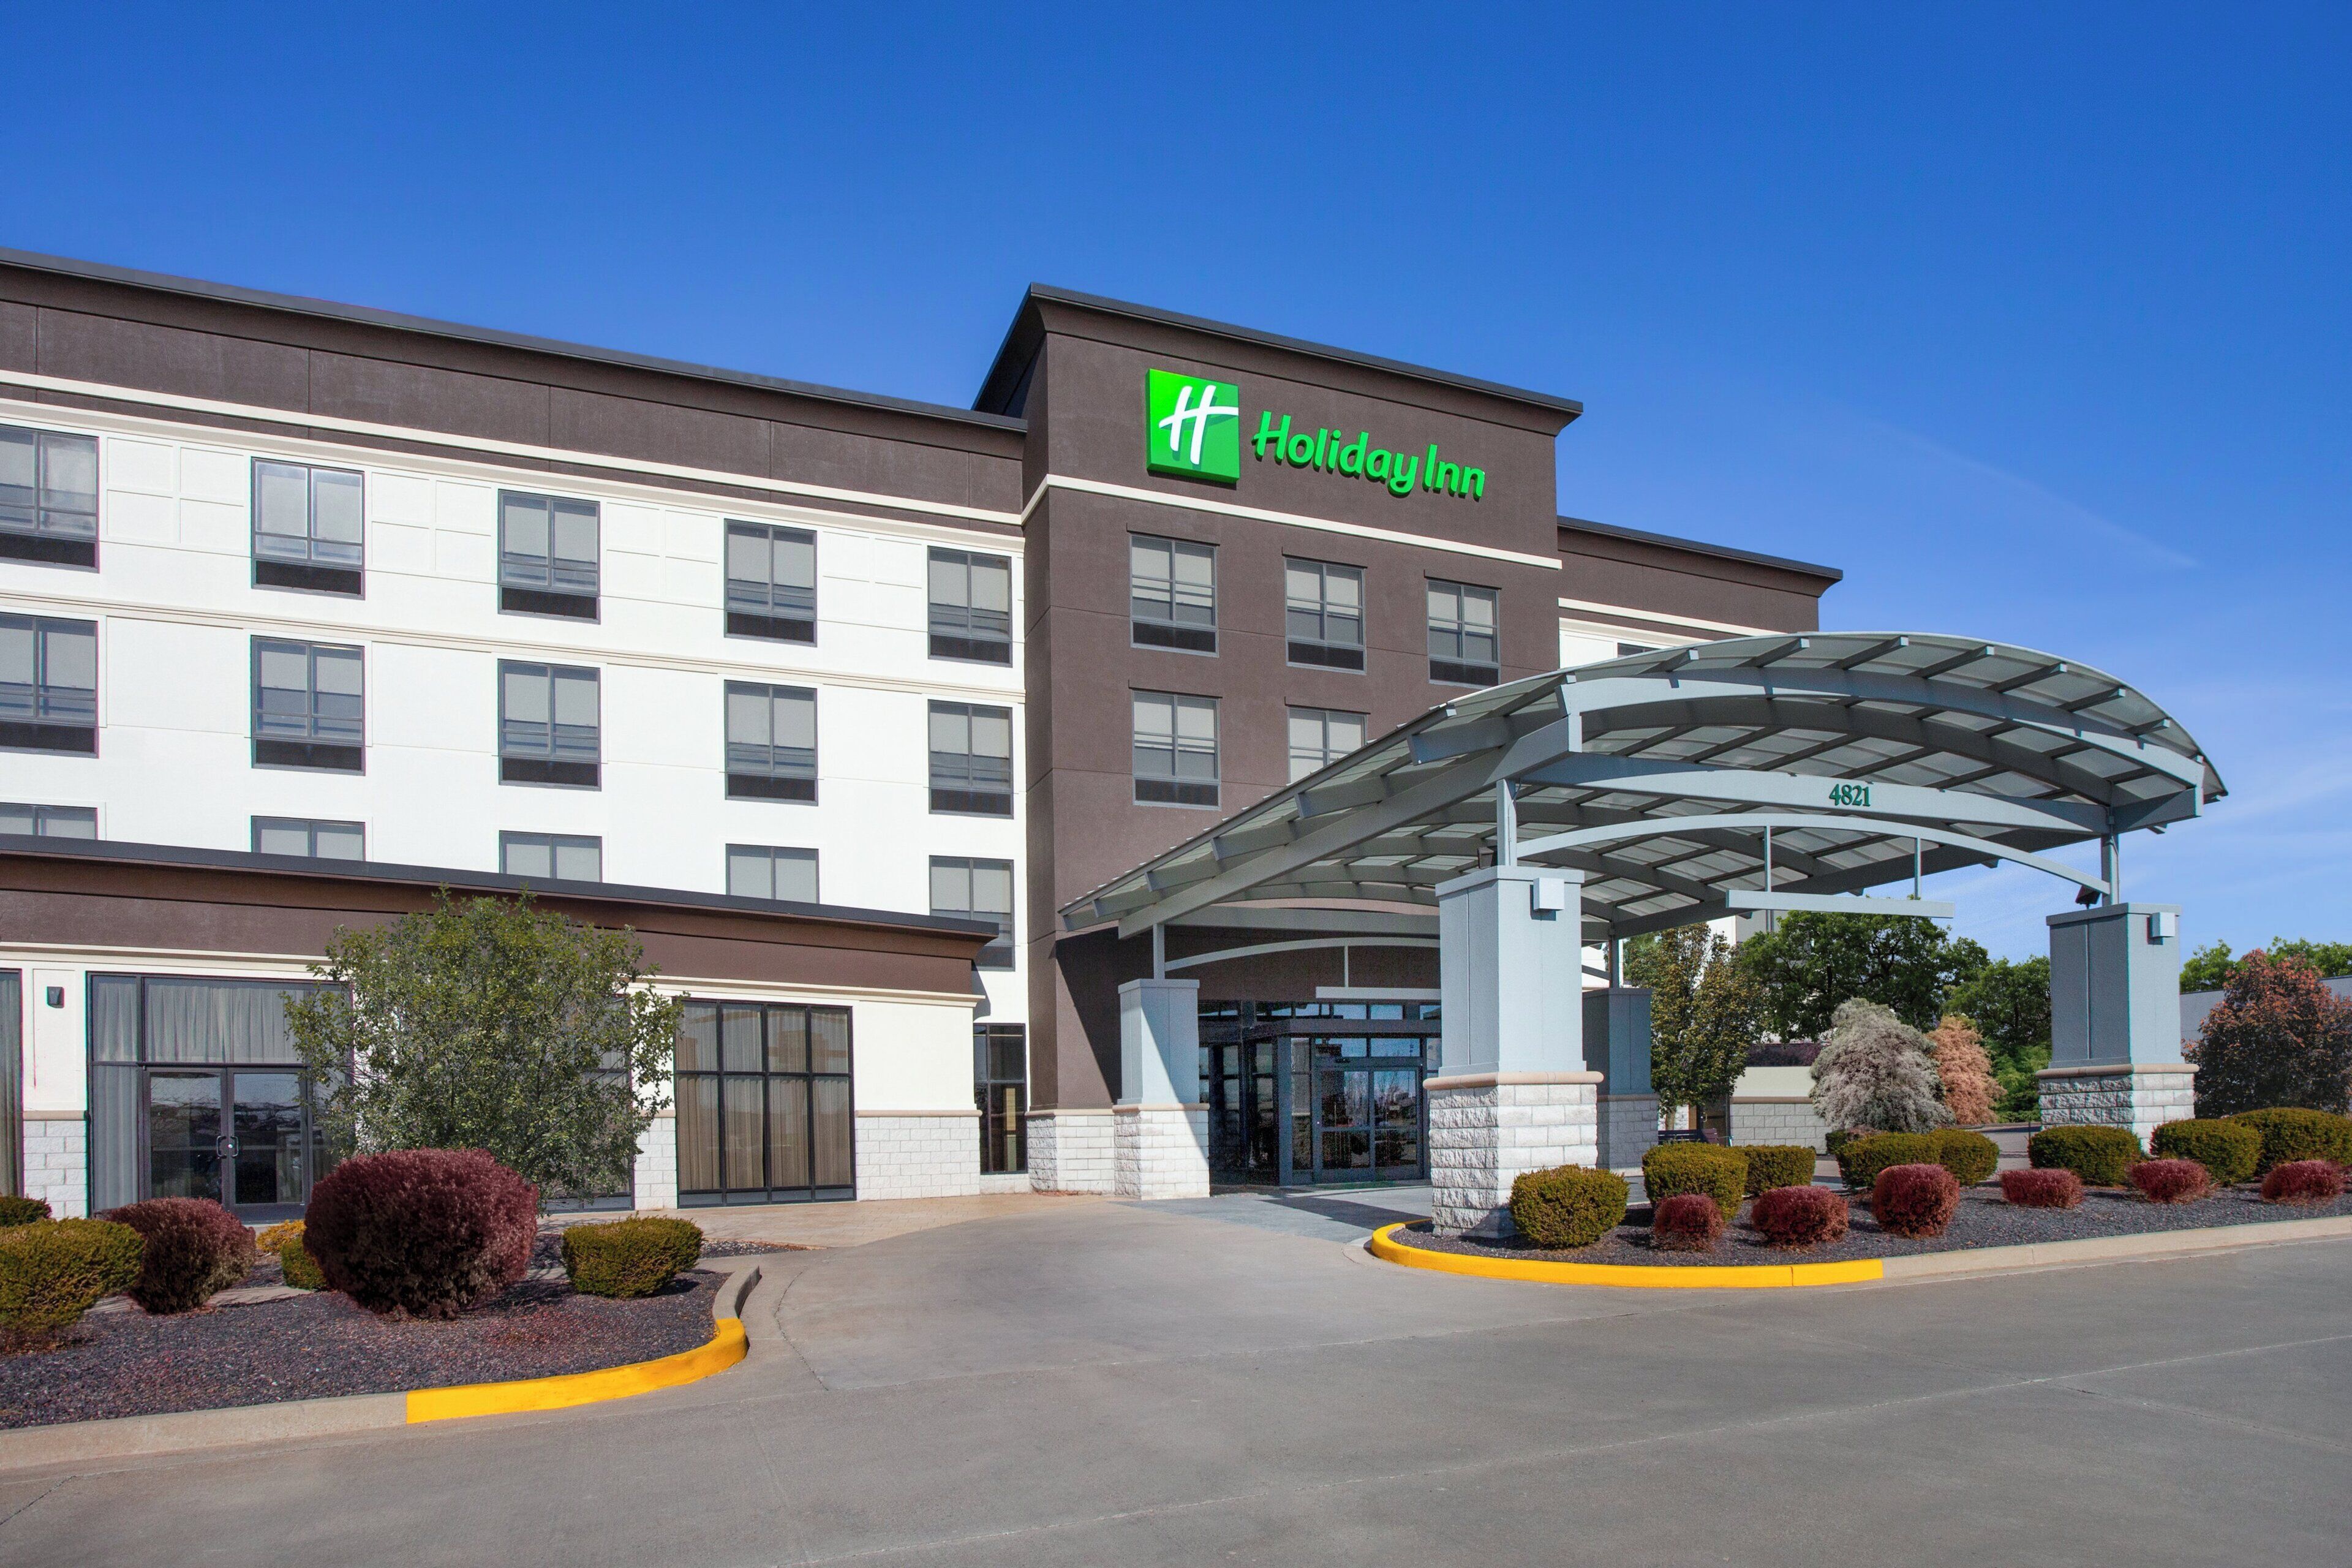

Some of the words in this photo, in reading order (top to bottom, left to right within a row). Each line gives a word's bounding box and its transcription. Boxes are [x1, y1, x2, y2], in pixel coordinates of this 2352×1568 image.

[1252, 410, 1418, 496] Holiday
[1422, 444, 1485, 499] Inn
[1828, 783, 1871, 807] 4821
